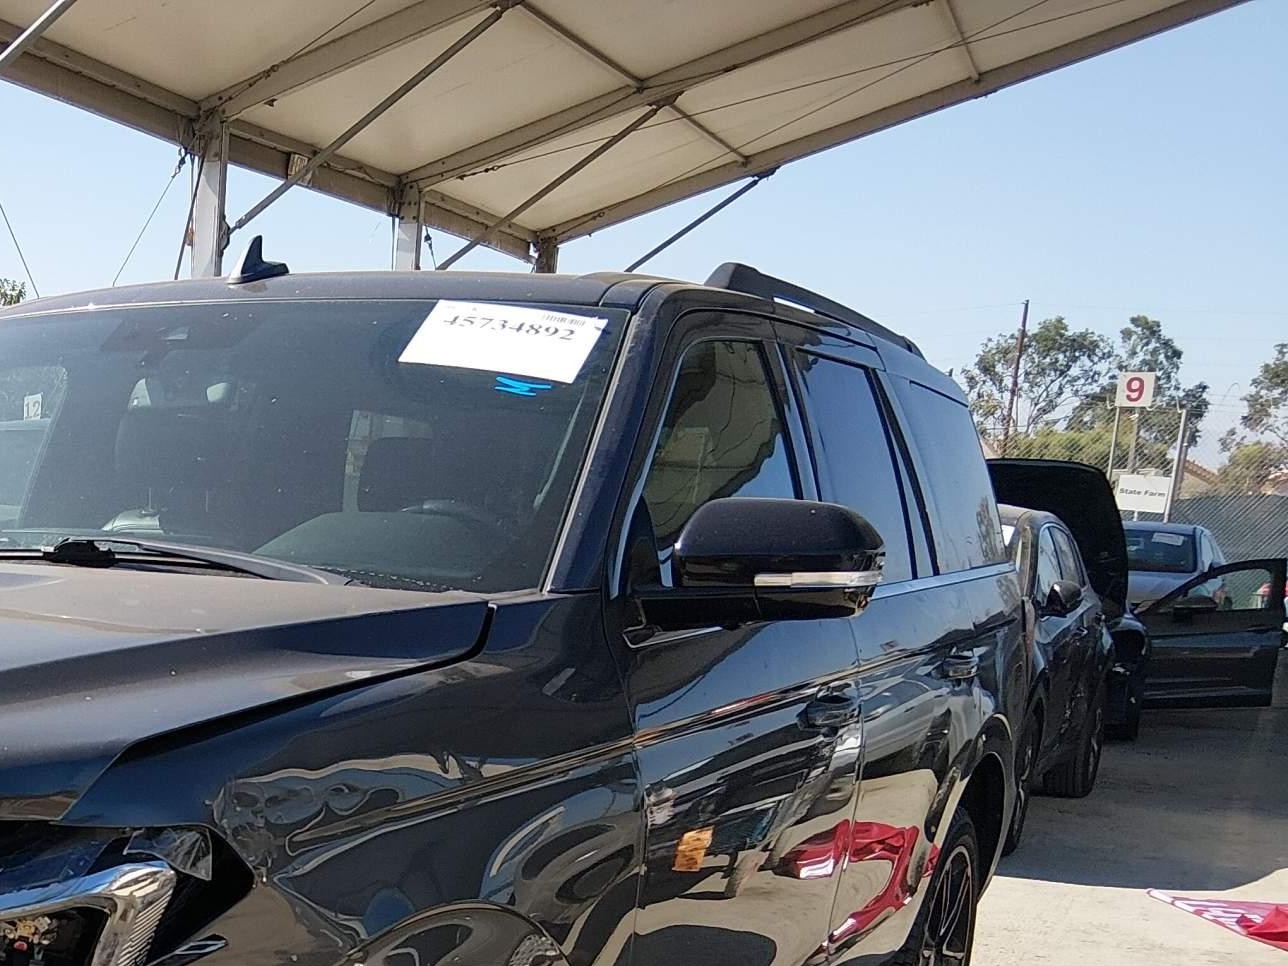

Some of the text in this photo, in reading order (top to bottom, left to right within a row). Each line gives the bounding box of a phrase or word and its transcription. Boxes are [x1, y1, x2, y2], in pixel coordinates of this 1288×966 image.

[444, 315, 575, 340] 45734892
[1125, 376, 1146, 403] 9
[24, 399, 41, 419] 12
[1119, 487, 1166, 497] State Farm
